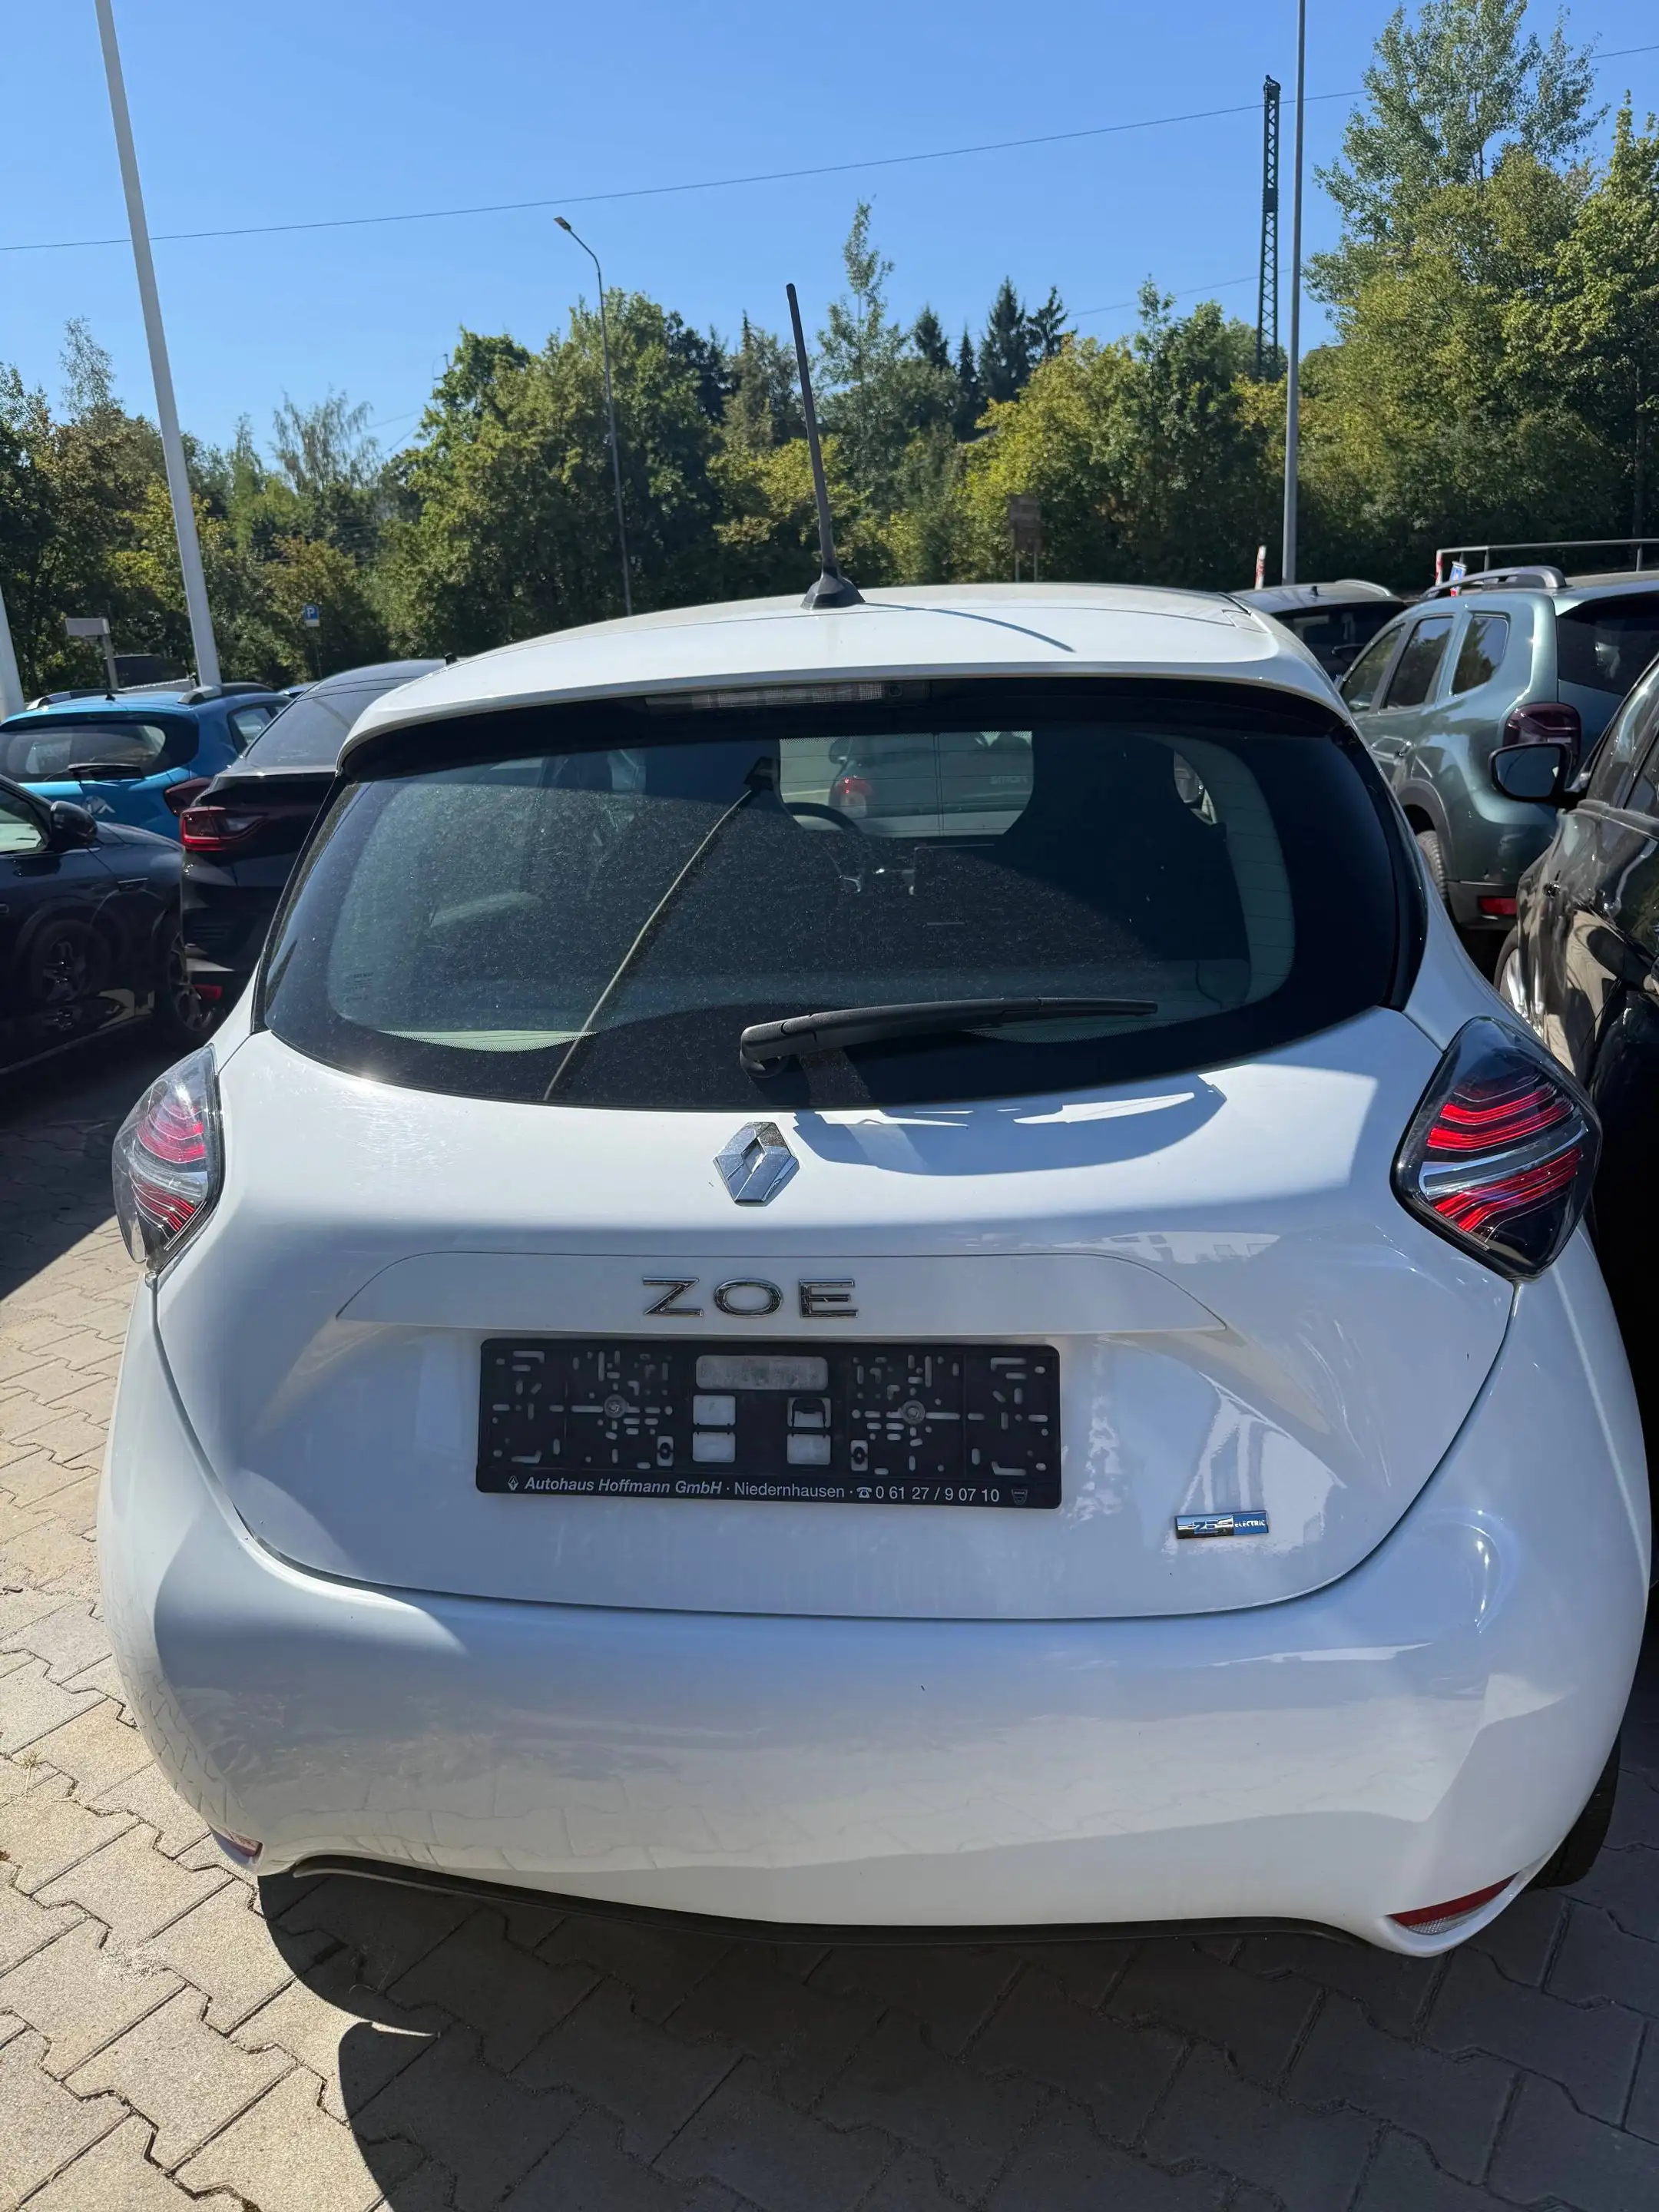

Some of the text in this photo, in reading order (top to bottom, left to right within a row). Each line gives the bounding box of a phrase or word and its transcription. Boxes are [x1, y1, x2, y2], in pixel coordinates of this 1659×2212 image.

[307, 608, 315, 618] P
[643, 1277, 859, 1319] ZOE
[524, 1477, 594, 1491] Autohaus
[598, 1479, 670, 1493] Hoffmann
[674, 1481, 722, 1495] GmbH
[734, 1482, 845, 1498] Niedernhausen
[876, 1485, 884, 1498] 0
[889, 1486, 905, 1499] 61
[912, 1487, 929, 1500] 27
[945, 1488, 953, 1501] 9
[959, 1488, 976, 1502] 07
[982, 1488, 999, 1502] 10
